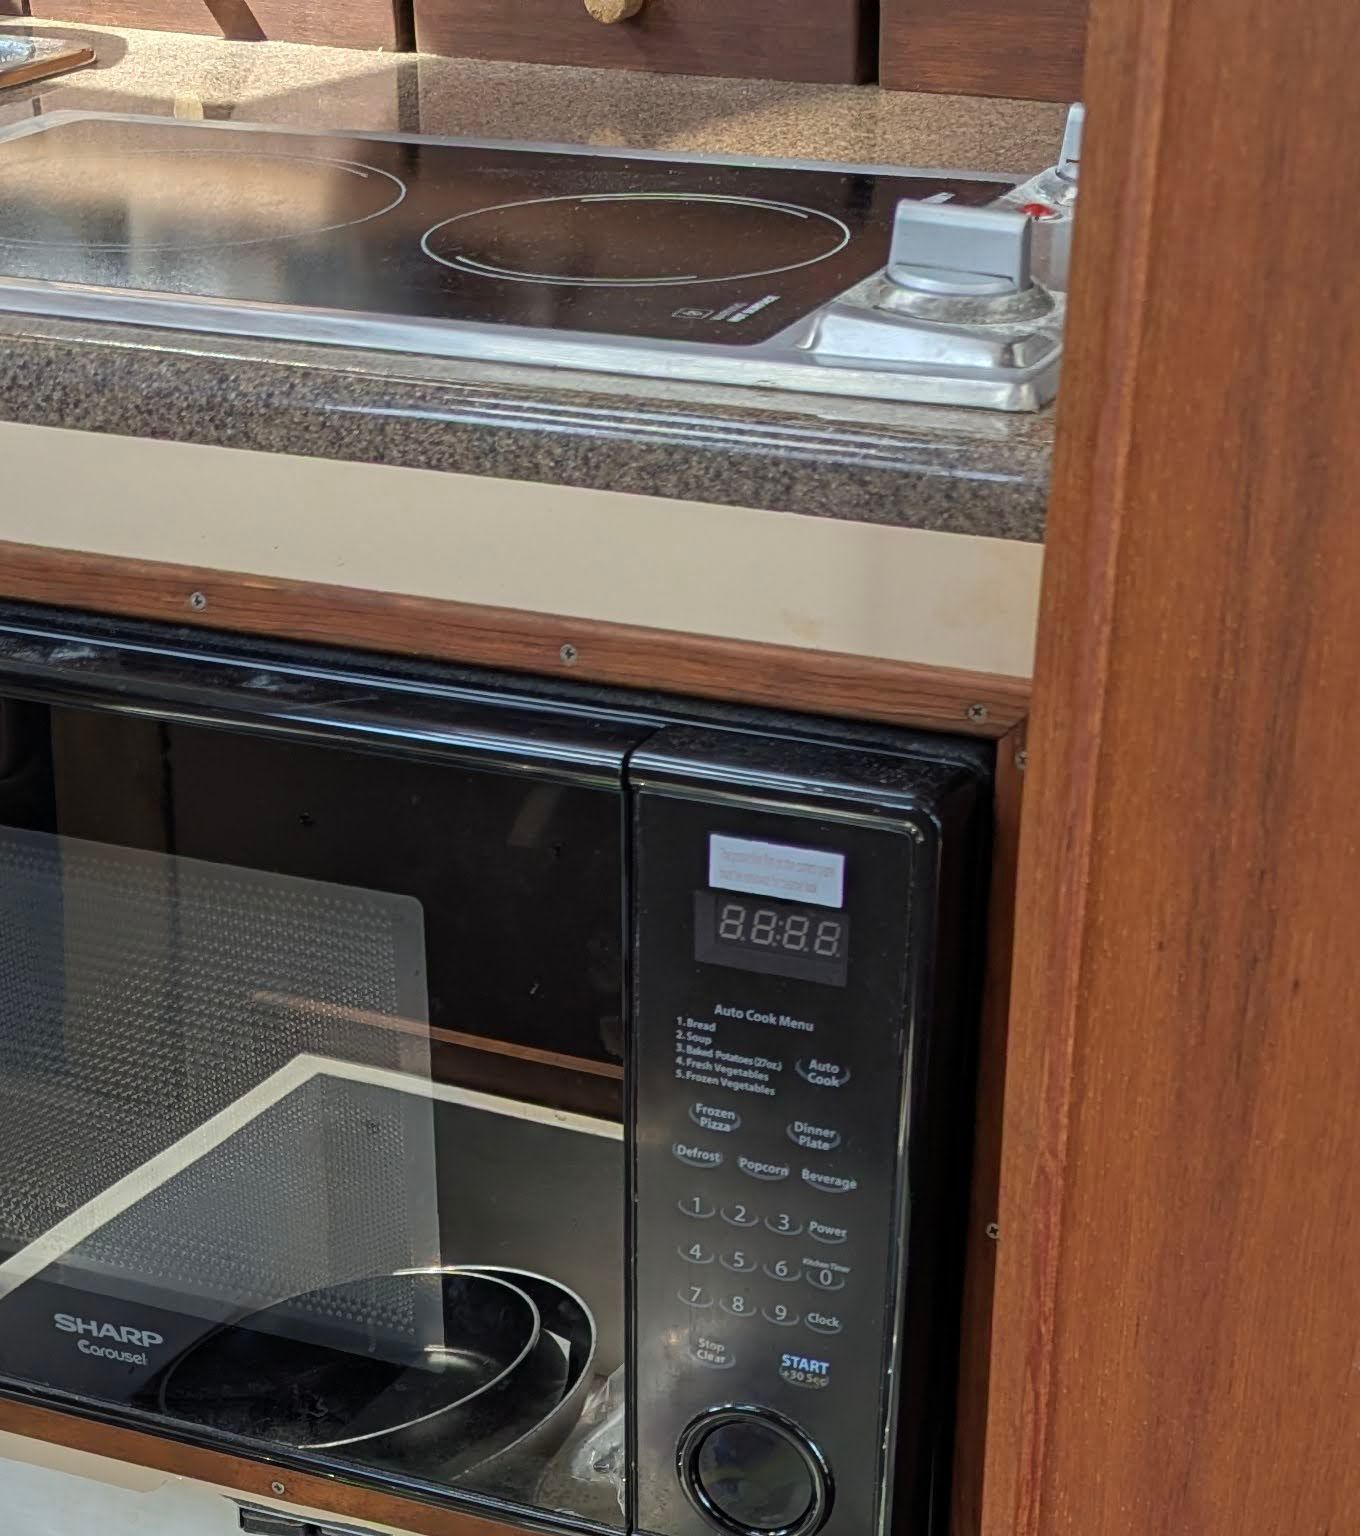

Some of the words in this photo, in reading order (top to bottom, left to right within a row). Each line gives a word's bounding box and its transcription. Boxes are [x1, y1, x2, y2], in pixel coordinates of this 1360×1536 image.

[687, 1019, 716, 1032] Bread
[715, 1004, 743, 1018] Auto
[746, 1010, 776, 1025] Cook
[779, 1016, 815, 1031] Menu
[687, 1031, 712, 1046] Soup
[687, 1058, 712, 1071] Fresh
[714, 1063, 769, 1081] Vegetables
[809, 1059, 839, 1073] Auto
[686, 1071, 719, 1086] Frozen
[720, 1078, 775, 1096] Vegetables
[808, 1072, 840, 1087] Cook
[696, 1103, 735, 1120] Frozen
[700, 1117, 731, 1132] Pizza
[794, 1121, 836, 1138] Dinner
[799, 1136, 830, 1150] Plate
[678, 1144, 721, 1162] Defrost
[739, 1157, 789, 1177] Popcorn
[801, 1168, 857, 1190] Beverage
[693, 1197, 700, 1213] 1
[734, 1205, 746, 1222] 2
[778, 1214, 790, 1230] 3
[810, 1221, 847, 1237] Power
[690, 1244, 702, 1259] 4
[733, 1252, 744, 1267] 5
[775, 1260, 787, 1276] 6
[819, 1270, 832, 1285] 0
[691, 1287, 702, 1302] 7
[733, 1296, 744, 1312] 8
[775, 1305, 787, 1320] 9
[808, 1313, 840, 1328] Clock
[54, 1313, 164, 1347] SHARP
[77, 1339, 148, 1365] Carousel
[699, 1338, 725, 1352] Stop
[697, 1351, 726, 1364] Clear
[782, 1354, 830, 1375] START
